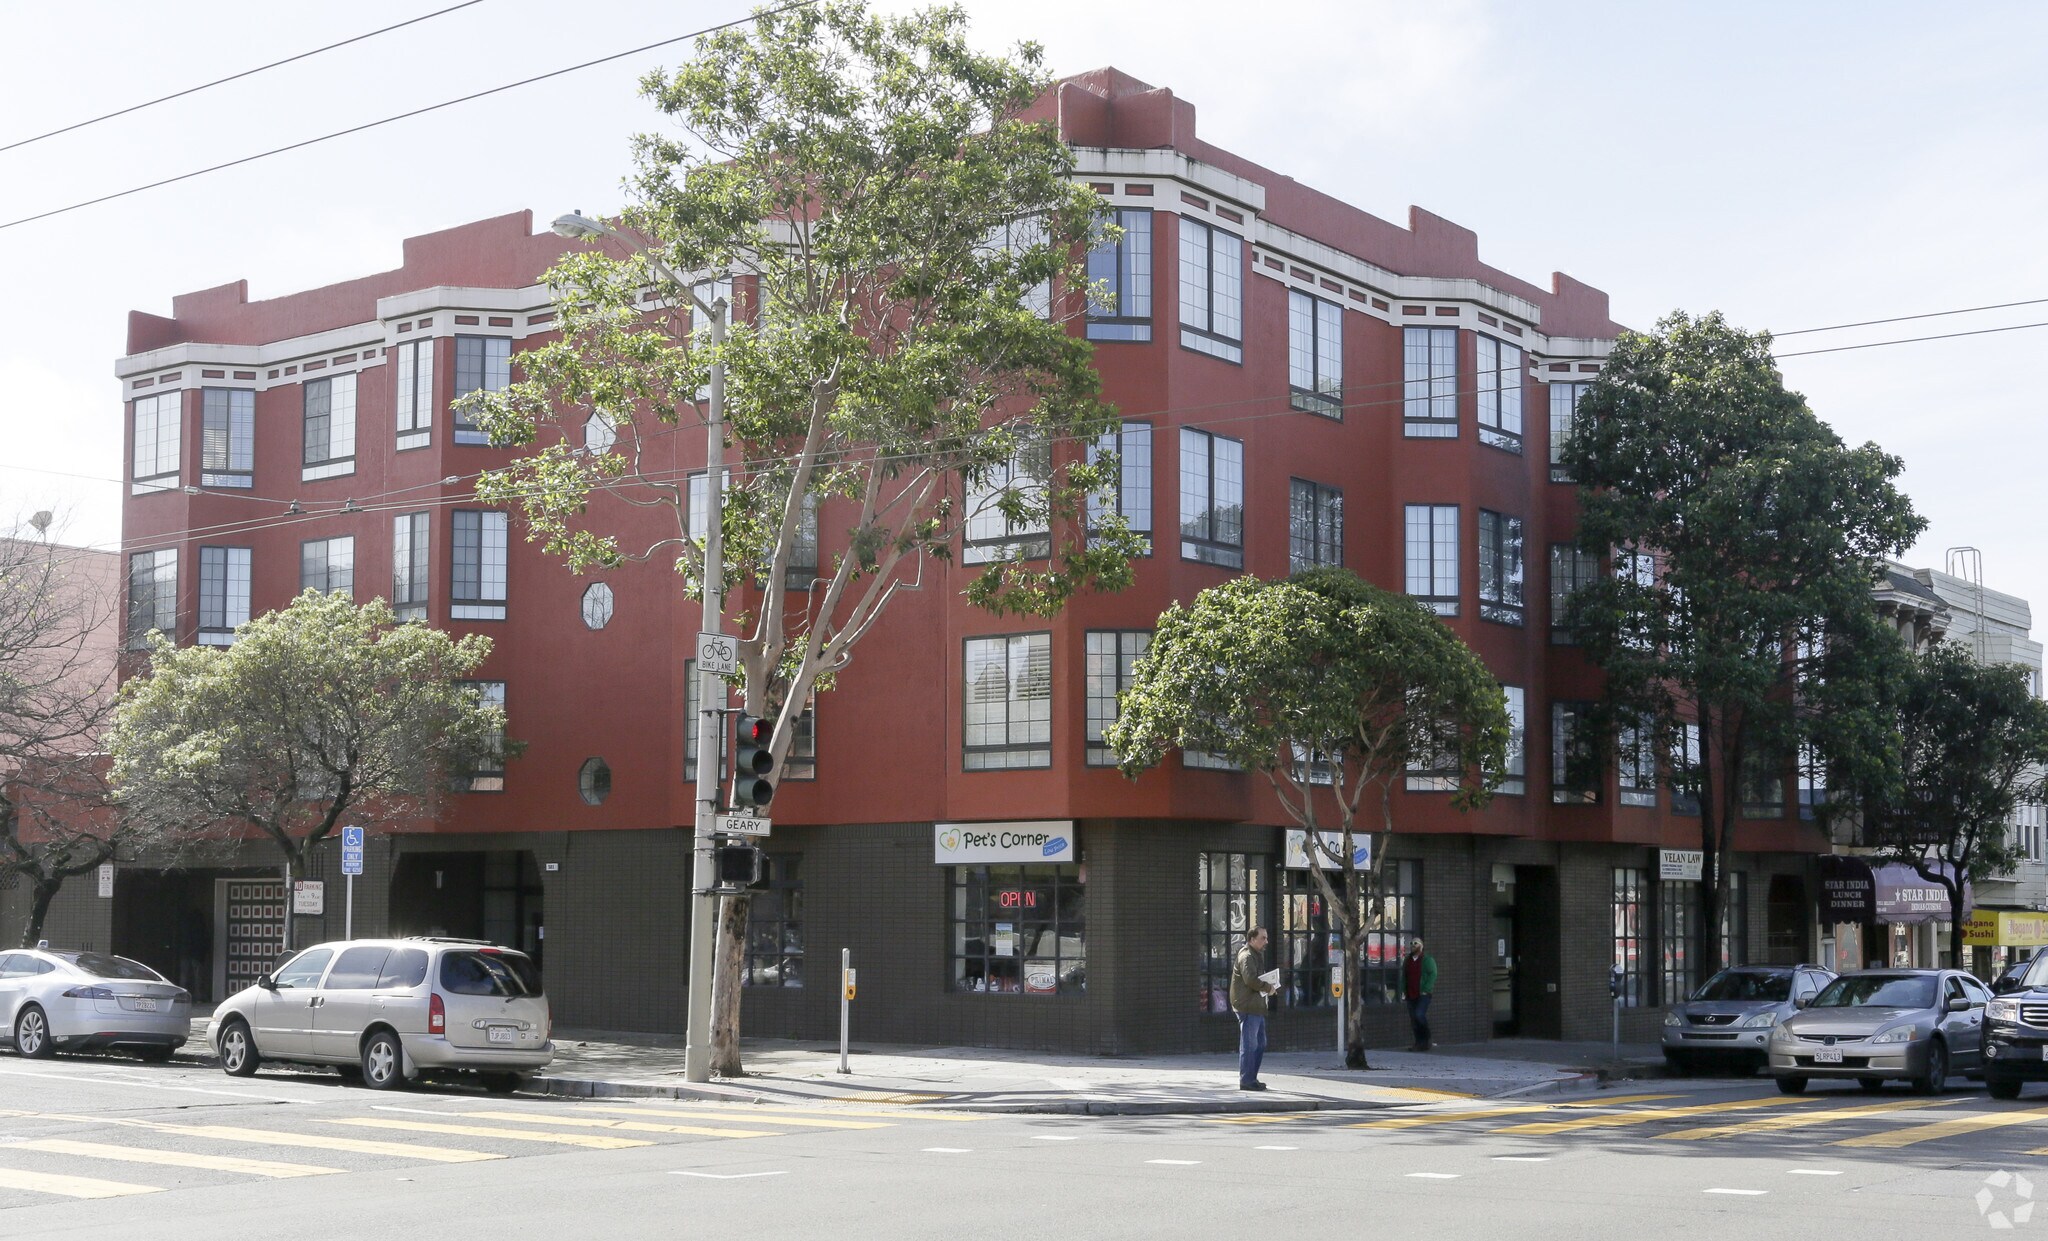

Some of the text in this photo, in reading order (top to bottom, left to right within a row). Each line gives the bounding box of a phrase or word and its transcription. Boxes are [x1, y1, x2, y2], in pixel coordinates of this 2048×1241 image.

[702, 660, 732, 671] BIKE LANE
[726, 819, 761, 831] GEARY
[963, 832, 1050, 849] Pet's Corner
[1664, 853, 1702, 864] VELAN LAW
[295, 881, 303, 890] NO
[1825, 880, 1869, 890] STAR INDIA
[1832, 891, 1862, 899] LUNCH
[1902, 888, 1949, 902] STAR INDIA
[1830, 900, 1865, 909] DINNER
[1969, 930, 1994, 938] Sushi
